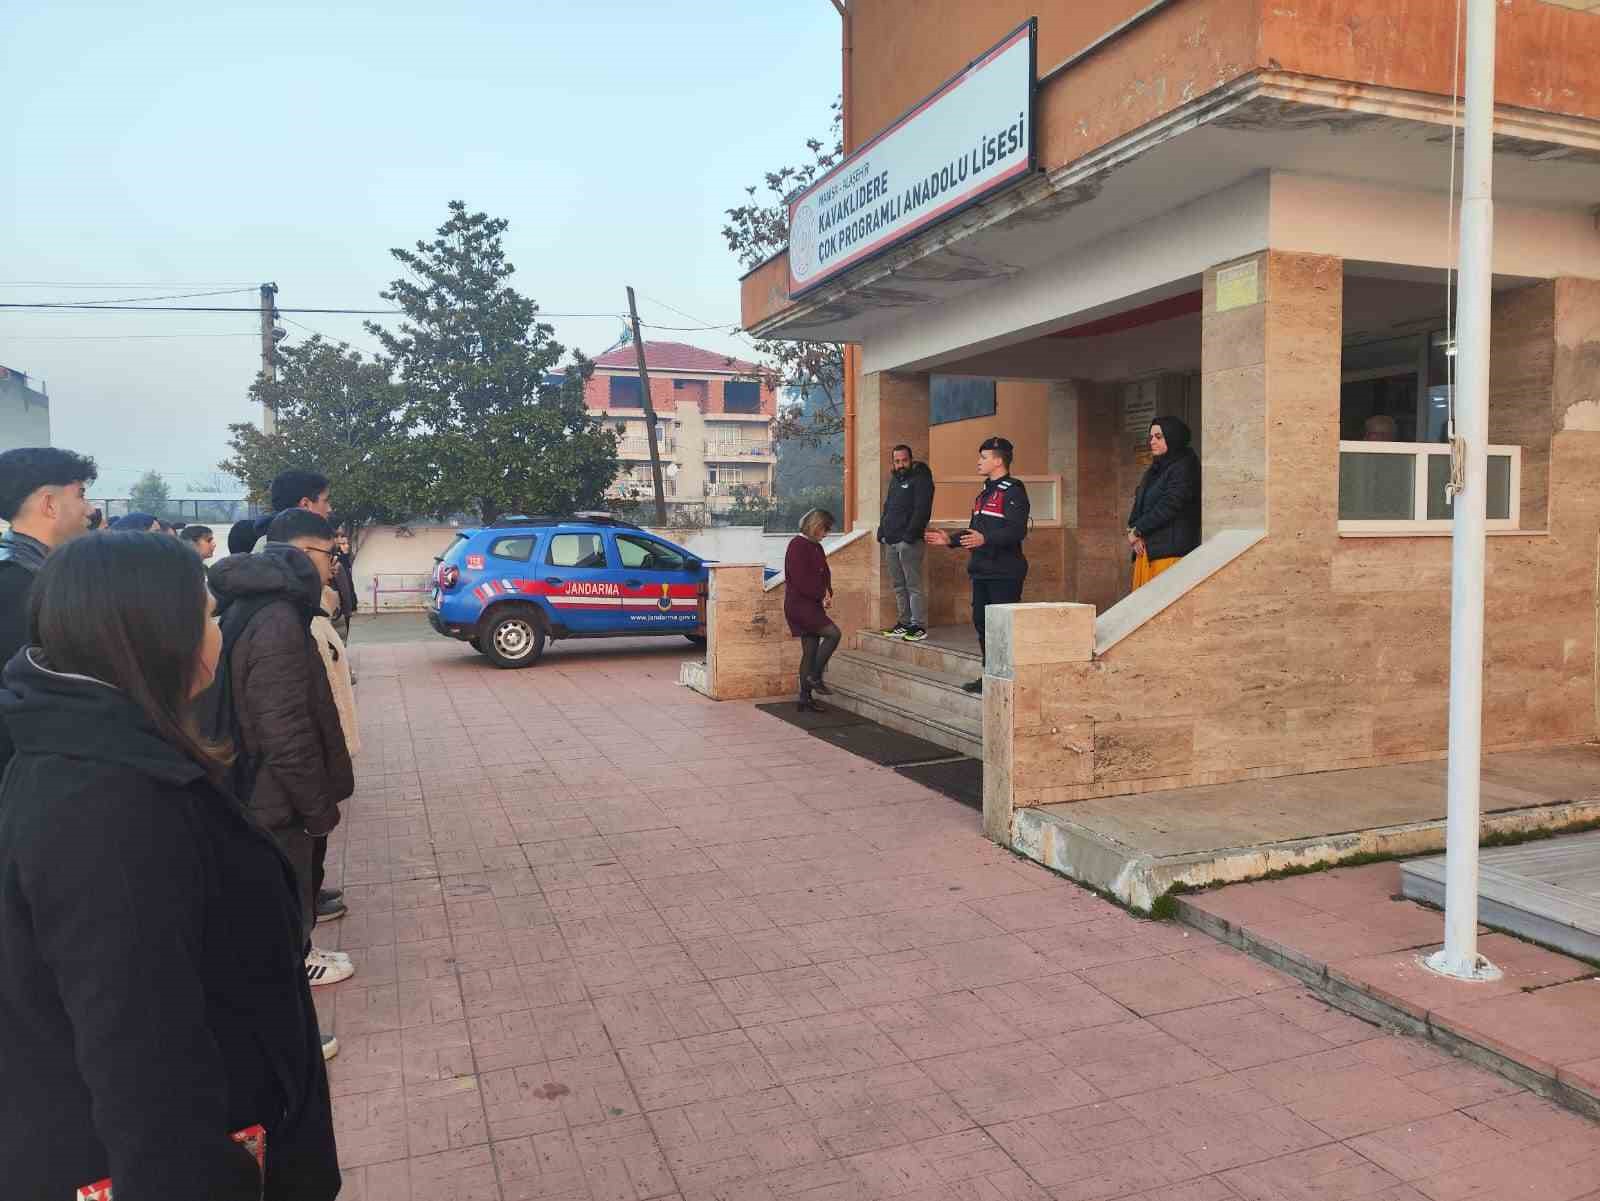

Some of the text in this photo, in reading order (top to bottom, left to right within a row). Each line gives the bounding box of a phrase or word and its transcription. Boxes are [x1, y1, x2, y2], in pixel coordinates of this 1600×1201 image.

[818, 112, 1024, 264] ÇOK PROGRAMLI ANADOLU LİSESİ
[818, 171, 889, 233] KAVAKLIDERE
[565, 583, 619, 595] JANDARMA
